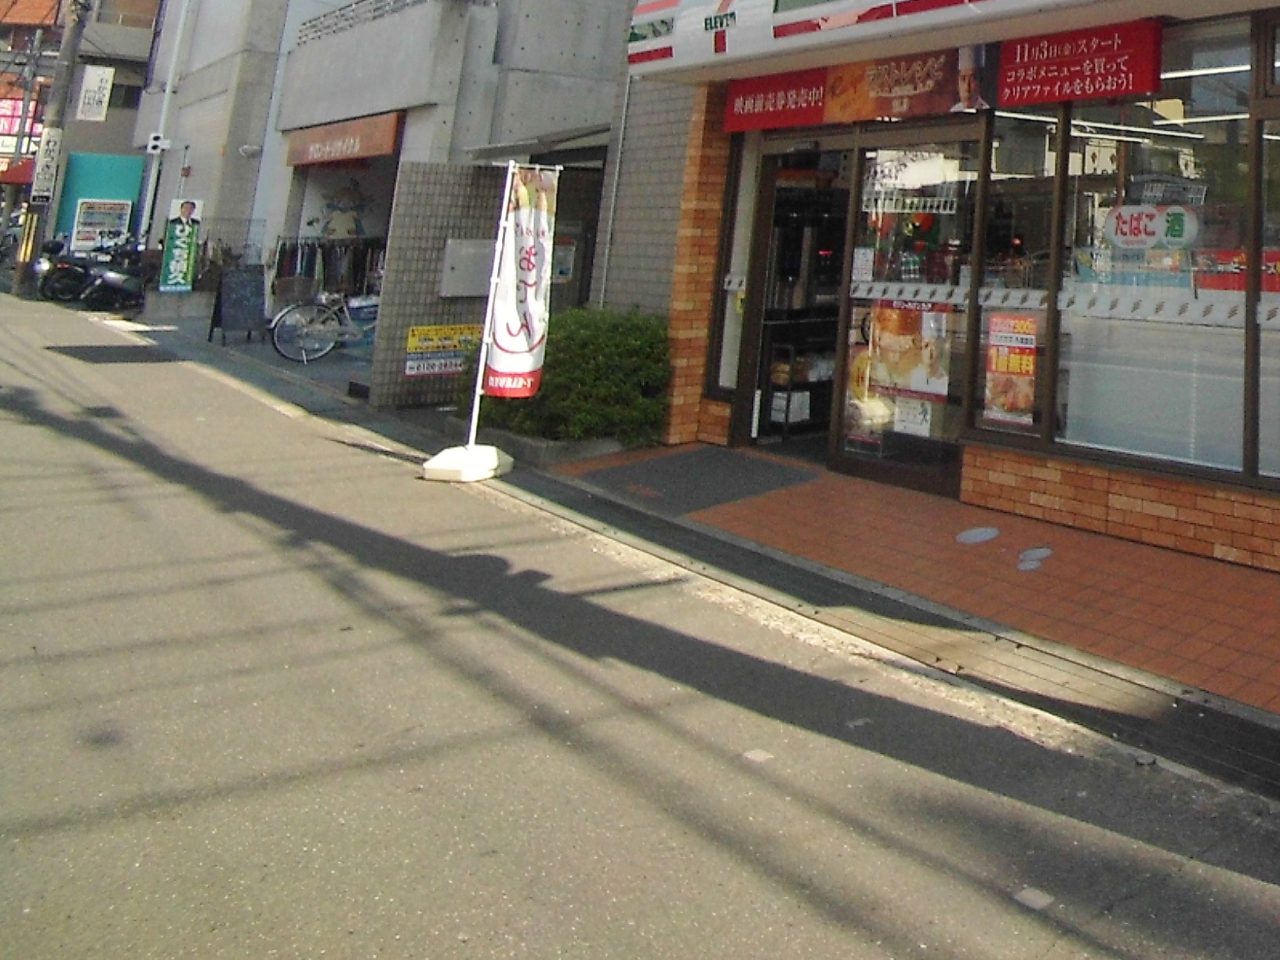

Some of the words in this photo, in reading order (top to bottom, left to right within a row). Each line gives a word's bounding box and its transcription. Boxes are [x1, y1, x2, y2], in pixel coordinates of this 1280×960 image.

[1006, 55, 1129, 82] コラボメニューを買って
[1115, 212, 1156, 237] たばこ
[1165, 212, 1184, 238] 酒
